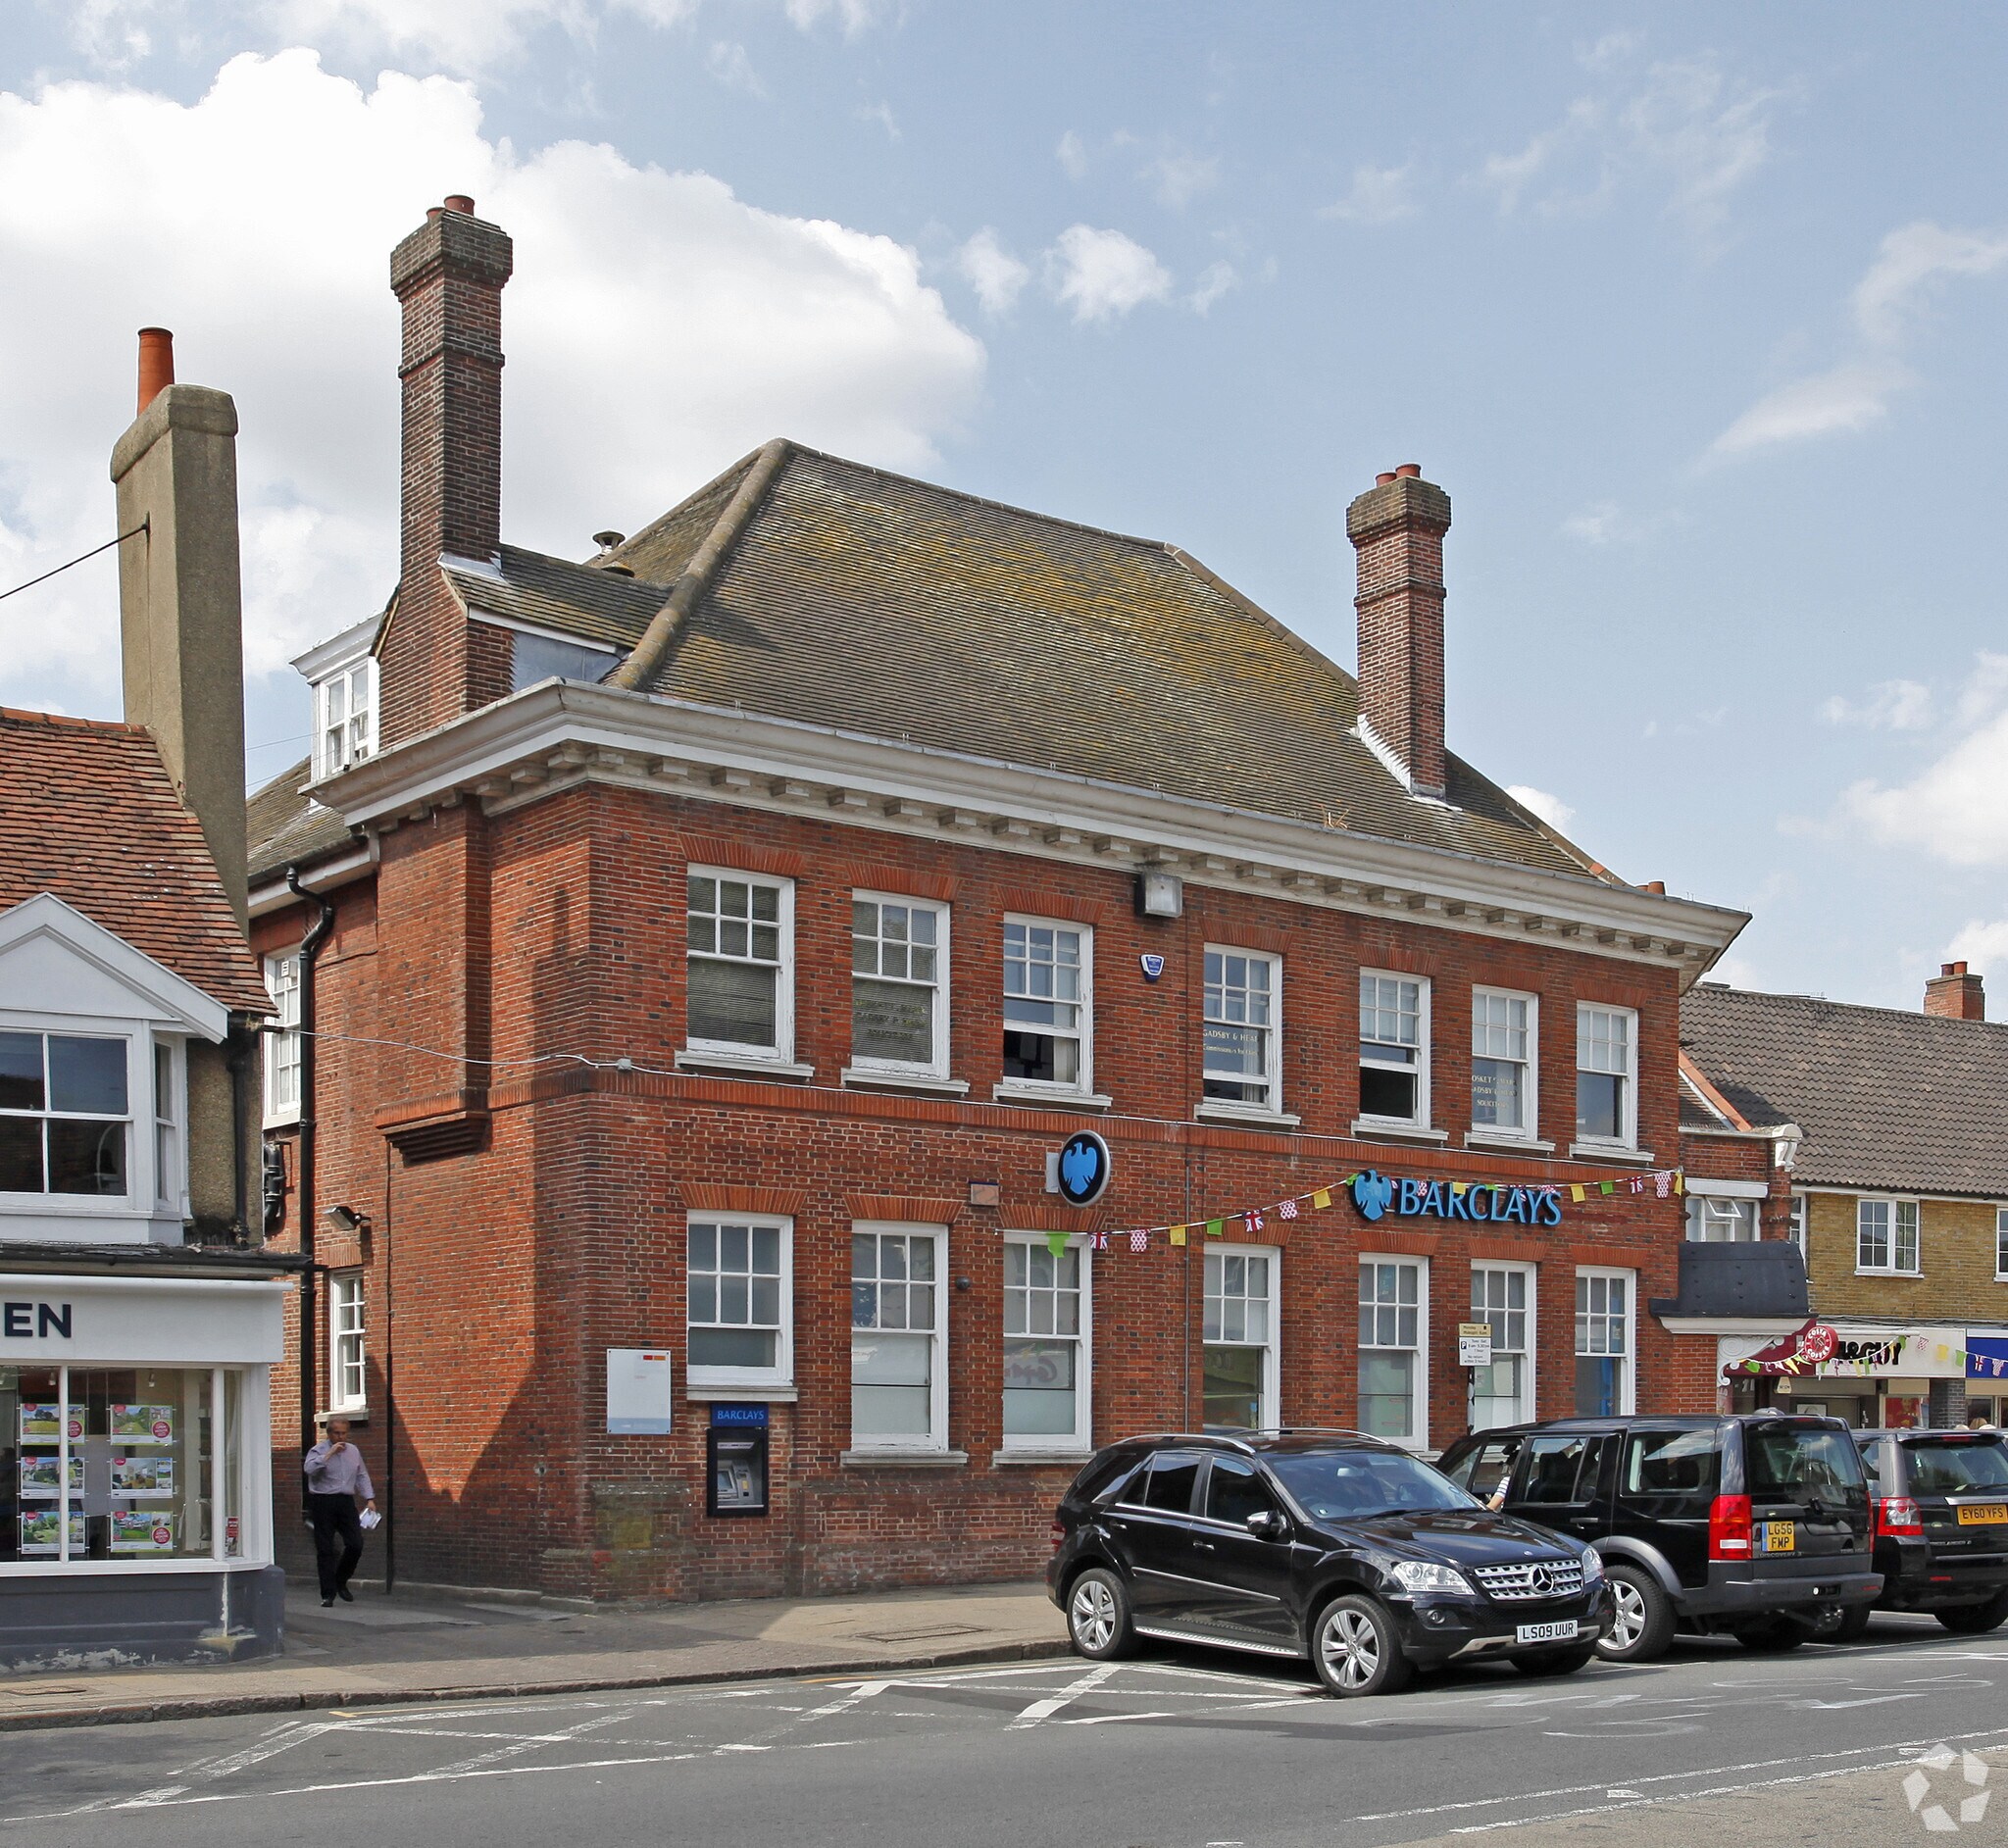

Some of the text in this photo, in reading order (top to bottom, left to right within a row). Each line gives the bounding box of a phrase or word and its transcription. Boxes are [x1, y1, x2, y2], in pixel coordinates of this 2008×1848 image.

[1399, 1179, 1562, 1226] BARCLAYS
[4, 1302, 72, 1338] EN
[1808, 1327, 1827, 1339] COSTA
[1807, 1346, 1830, 1359] COFFEE
[717, 1410, 765, 1420] BARCLAYS
[1962, 1508, 2004, 1519] EY60 YFS
[1768, 1523, 1792, 1535] LG56
[1523, 1623, 1574, 1639] LS09 UUR
